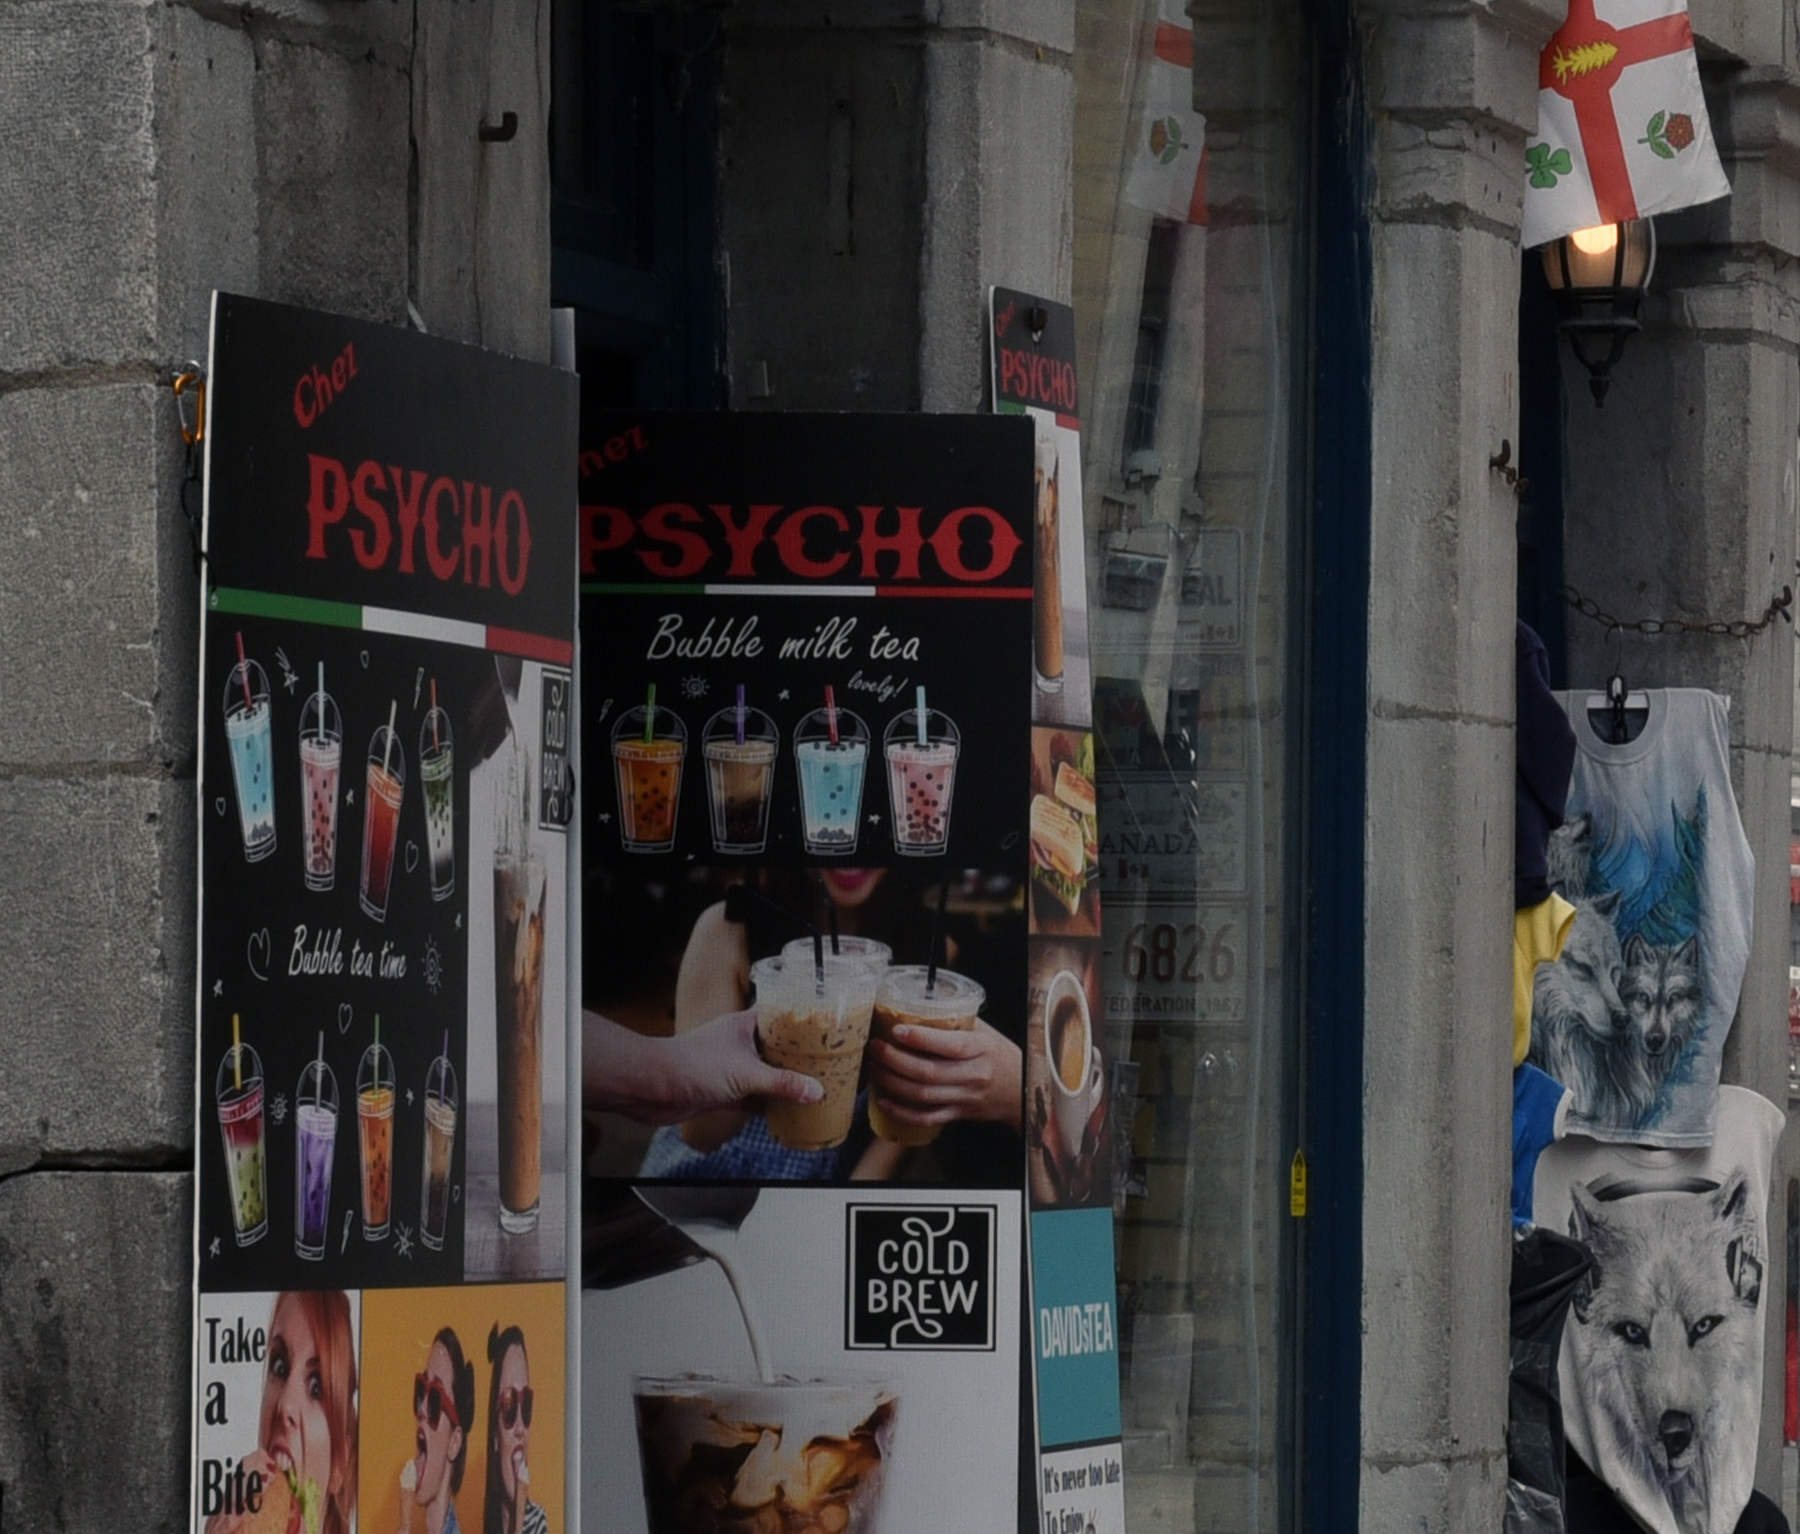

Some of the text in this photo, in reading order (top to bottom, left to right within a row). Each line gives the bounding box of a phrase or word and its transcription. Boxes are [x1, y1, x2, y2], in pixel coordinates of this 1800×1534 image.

[292, 340, 359, 432] Chez
[1001, 348, 1077, 410] PSYCHO
[305, 452, 533, 597] PSYCHO
[579, 502, 1024, 582] PSYCHO
[647, 613, 920, 661] Bubble milk tea
[848, 670, 909, 705] lovely!
[1100, 832, 1205, 855] ANADA
[288, 924, 407, 979] Bubble tea time
[878, 1230, 969, 1275] COLD
[867, 1278, 979, 1324] BREW
[205, 1316, 267, 1366] Take
[204, 1380, 228, 1428] a
[202, 1457, 264, 1519] Bite
[1062, 1468, 1087, 1491] never
